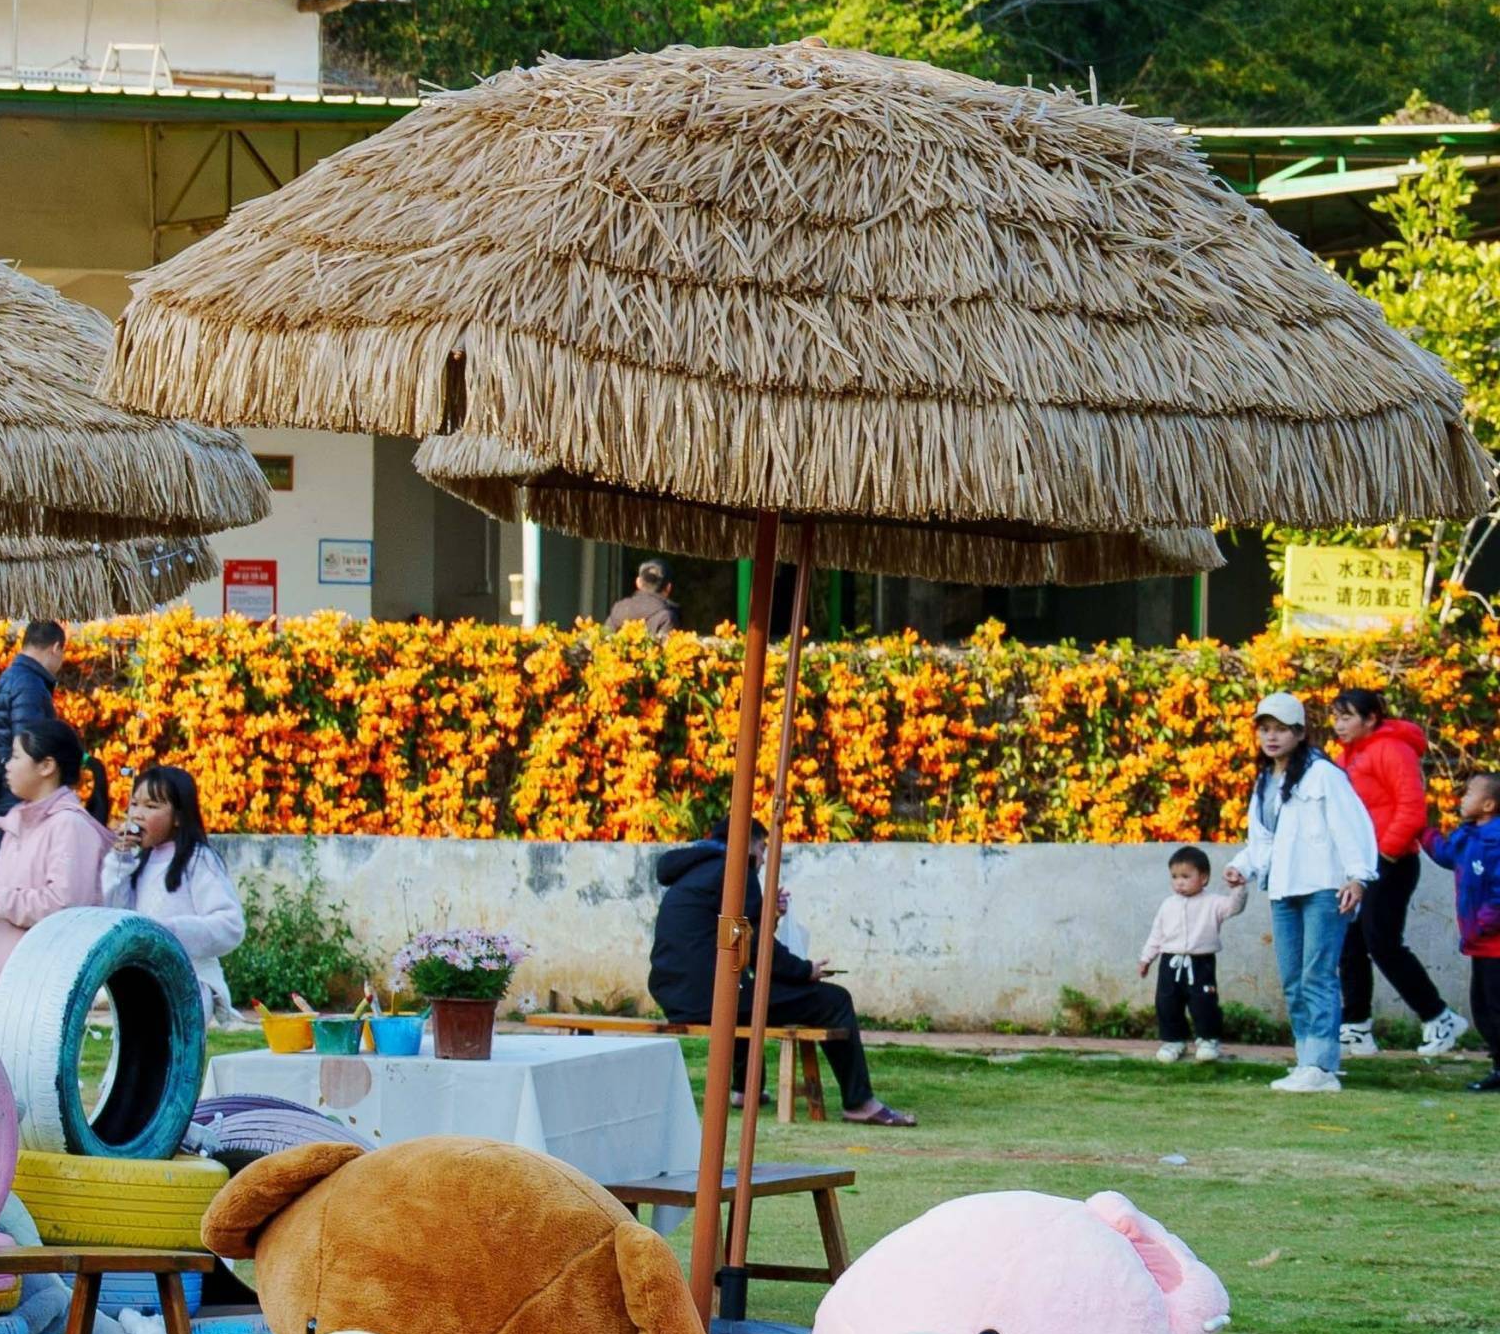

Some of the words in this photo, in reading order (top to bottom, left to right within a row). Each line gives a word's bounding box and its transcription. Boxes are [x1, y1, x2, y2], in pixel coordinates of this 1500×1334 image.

[1338, 558, 1413, 581] 水深危险
[1336, 586, 1411, 607] 请勿靠近
